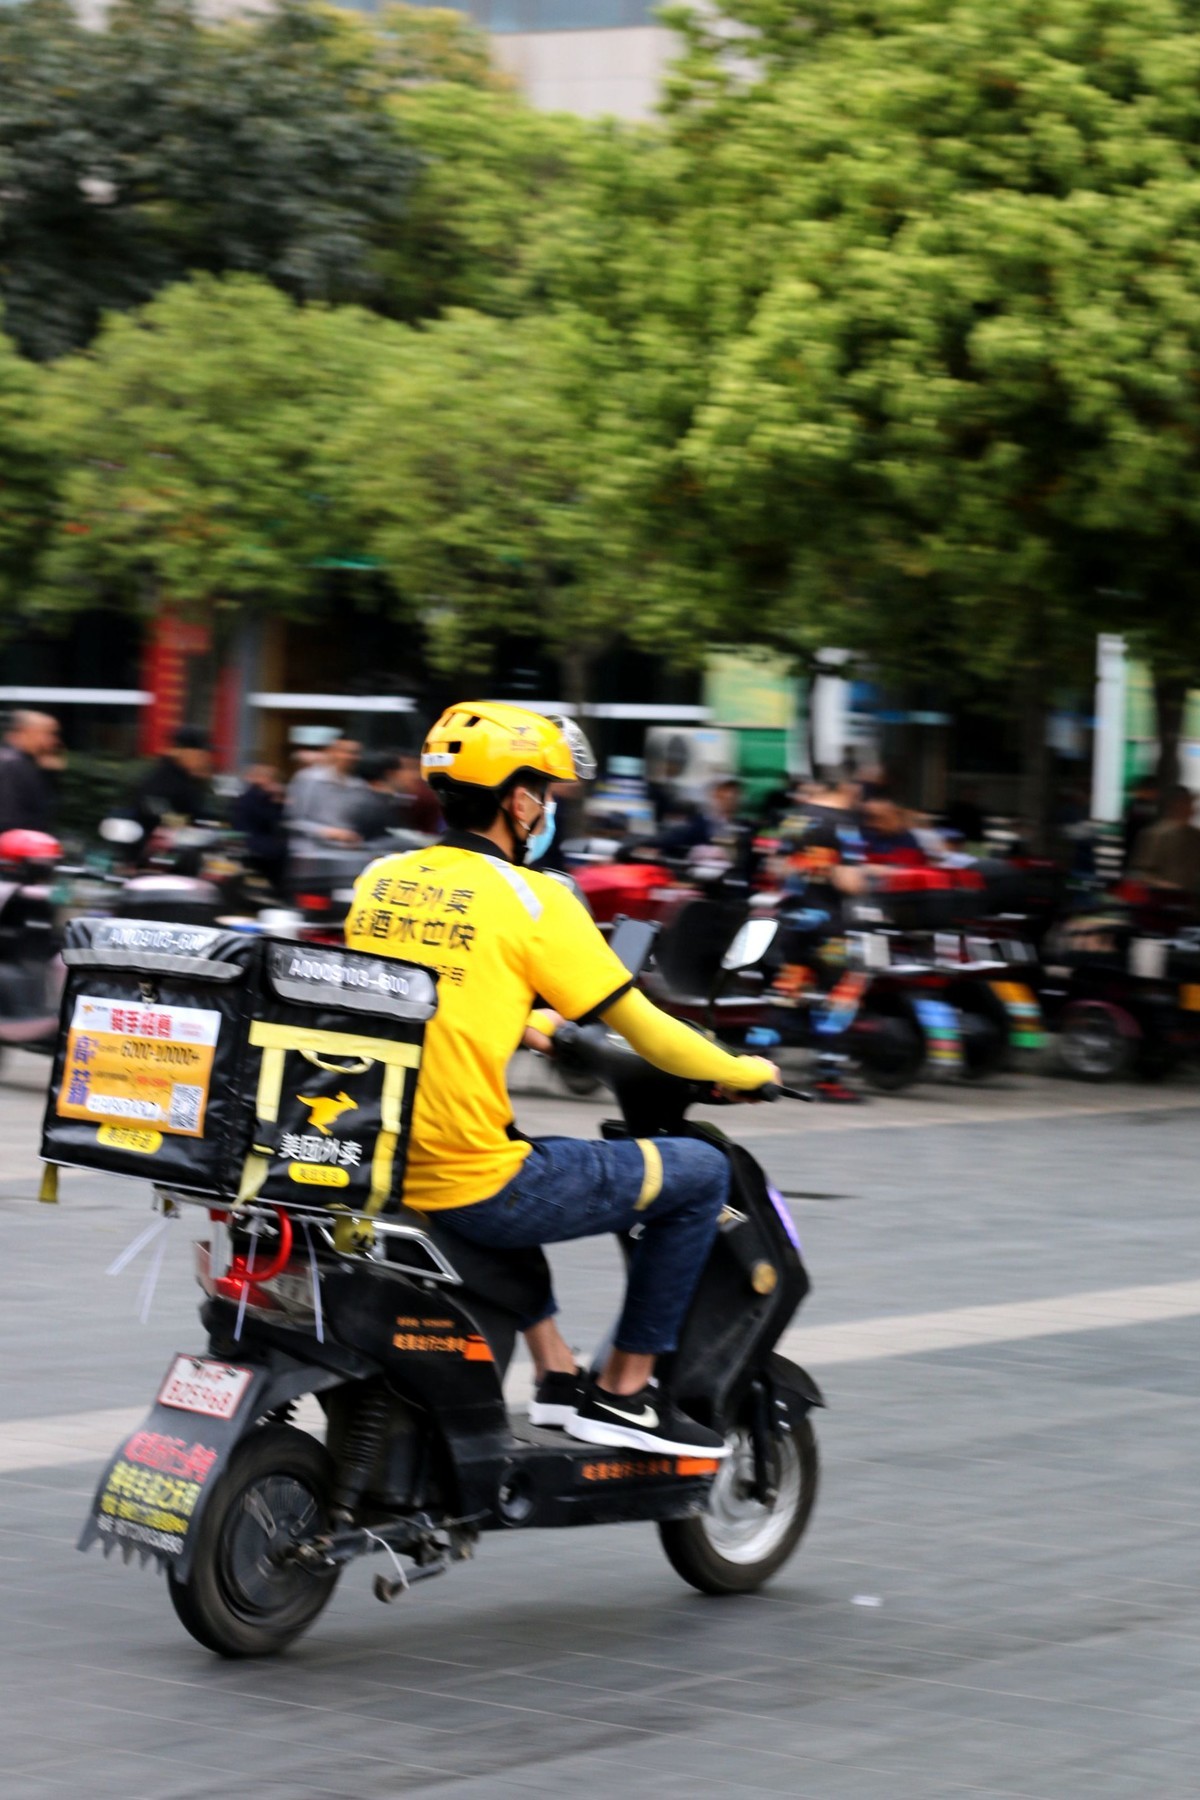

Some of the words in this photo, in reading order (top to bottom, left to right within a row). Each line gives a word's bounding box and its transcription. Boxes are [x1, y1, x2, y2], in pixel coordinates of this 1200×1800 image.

[371, 878, 475, 914] 美团外卖
[278, 1132, 362, 1167] 美团外卖
